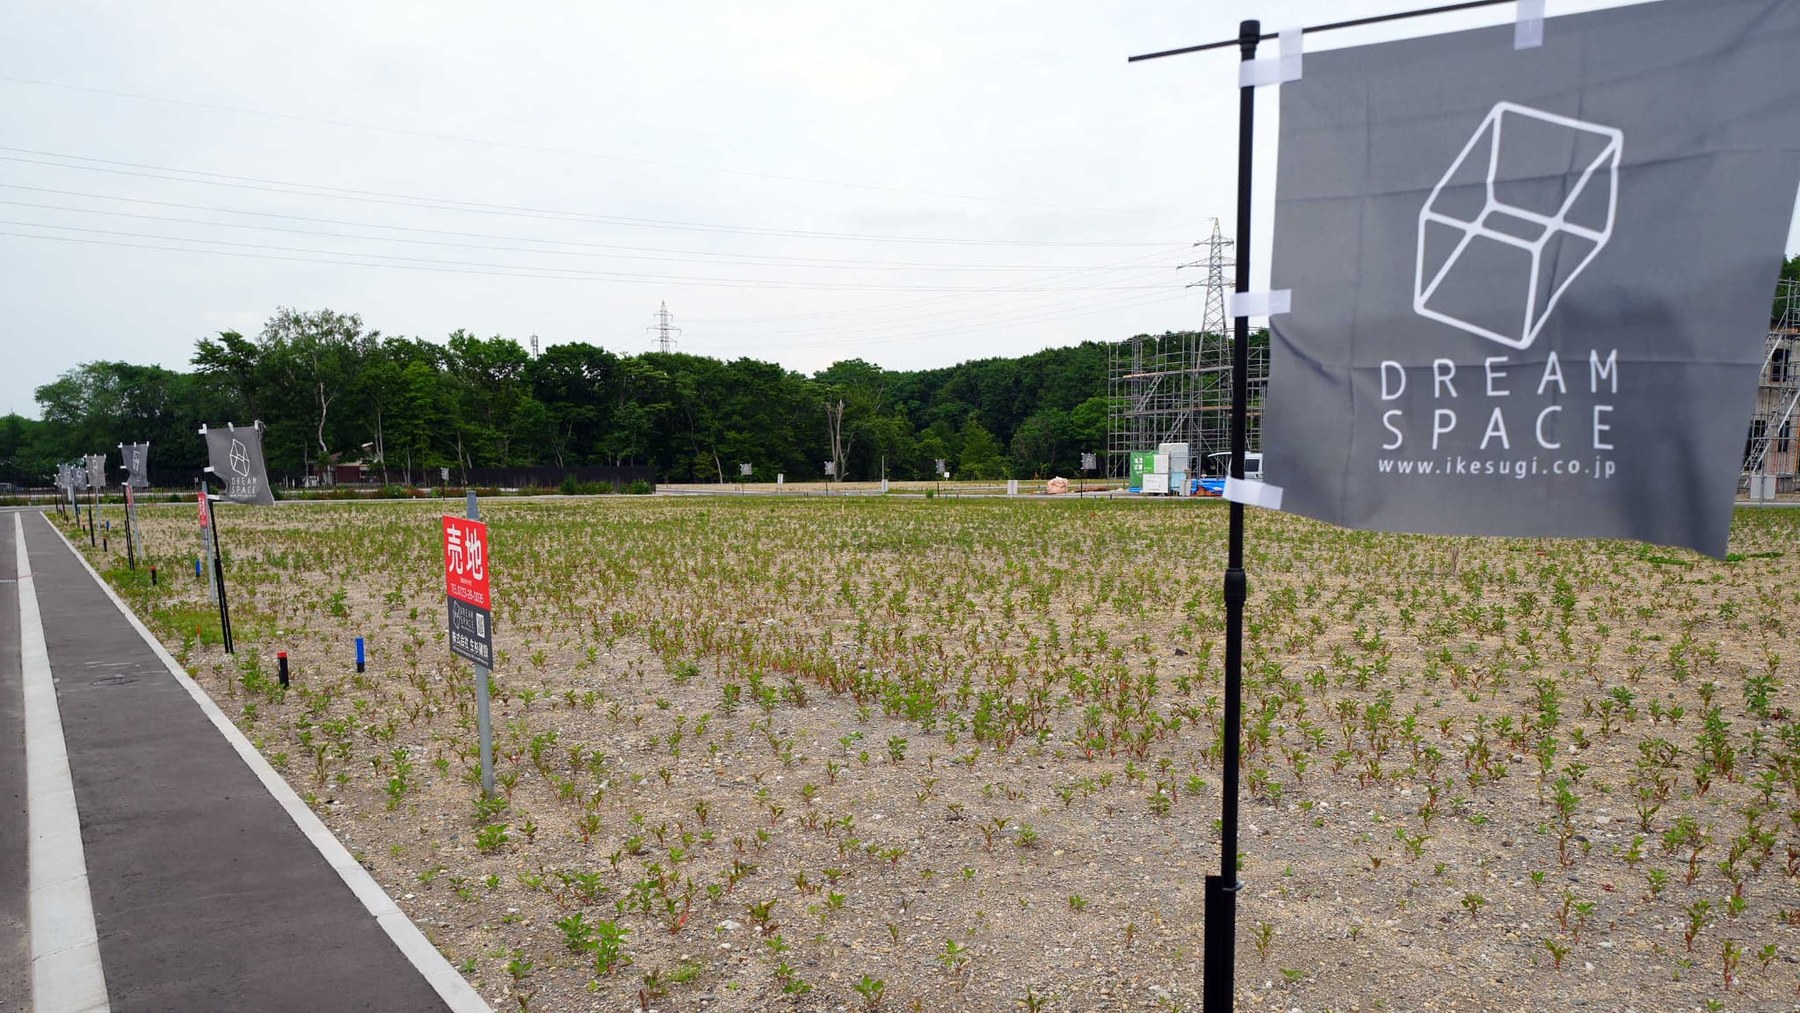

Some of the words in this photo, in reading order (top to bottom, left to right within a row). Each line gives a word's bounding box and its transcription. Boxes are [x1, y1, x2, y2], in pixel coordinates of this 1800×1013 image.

[1381, 349, 1618, 401] DREAM
[1382, 405, 1615, 450] SPACE
[231, 477, 257, 485] DREAM
[1378, 456, 1616, 479] www.ikesugi.co.jp
[231, 486, 256, 494] SPACE
[447, 523, 483, 580] 売地
